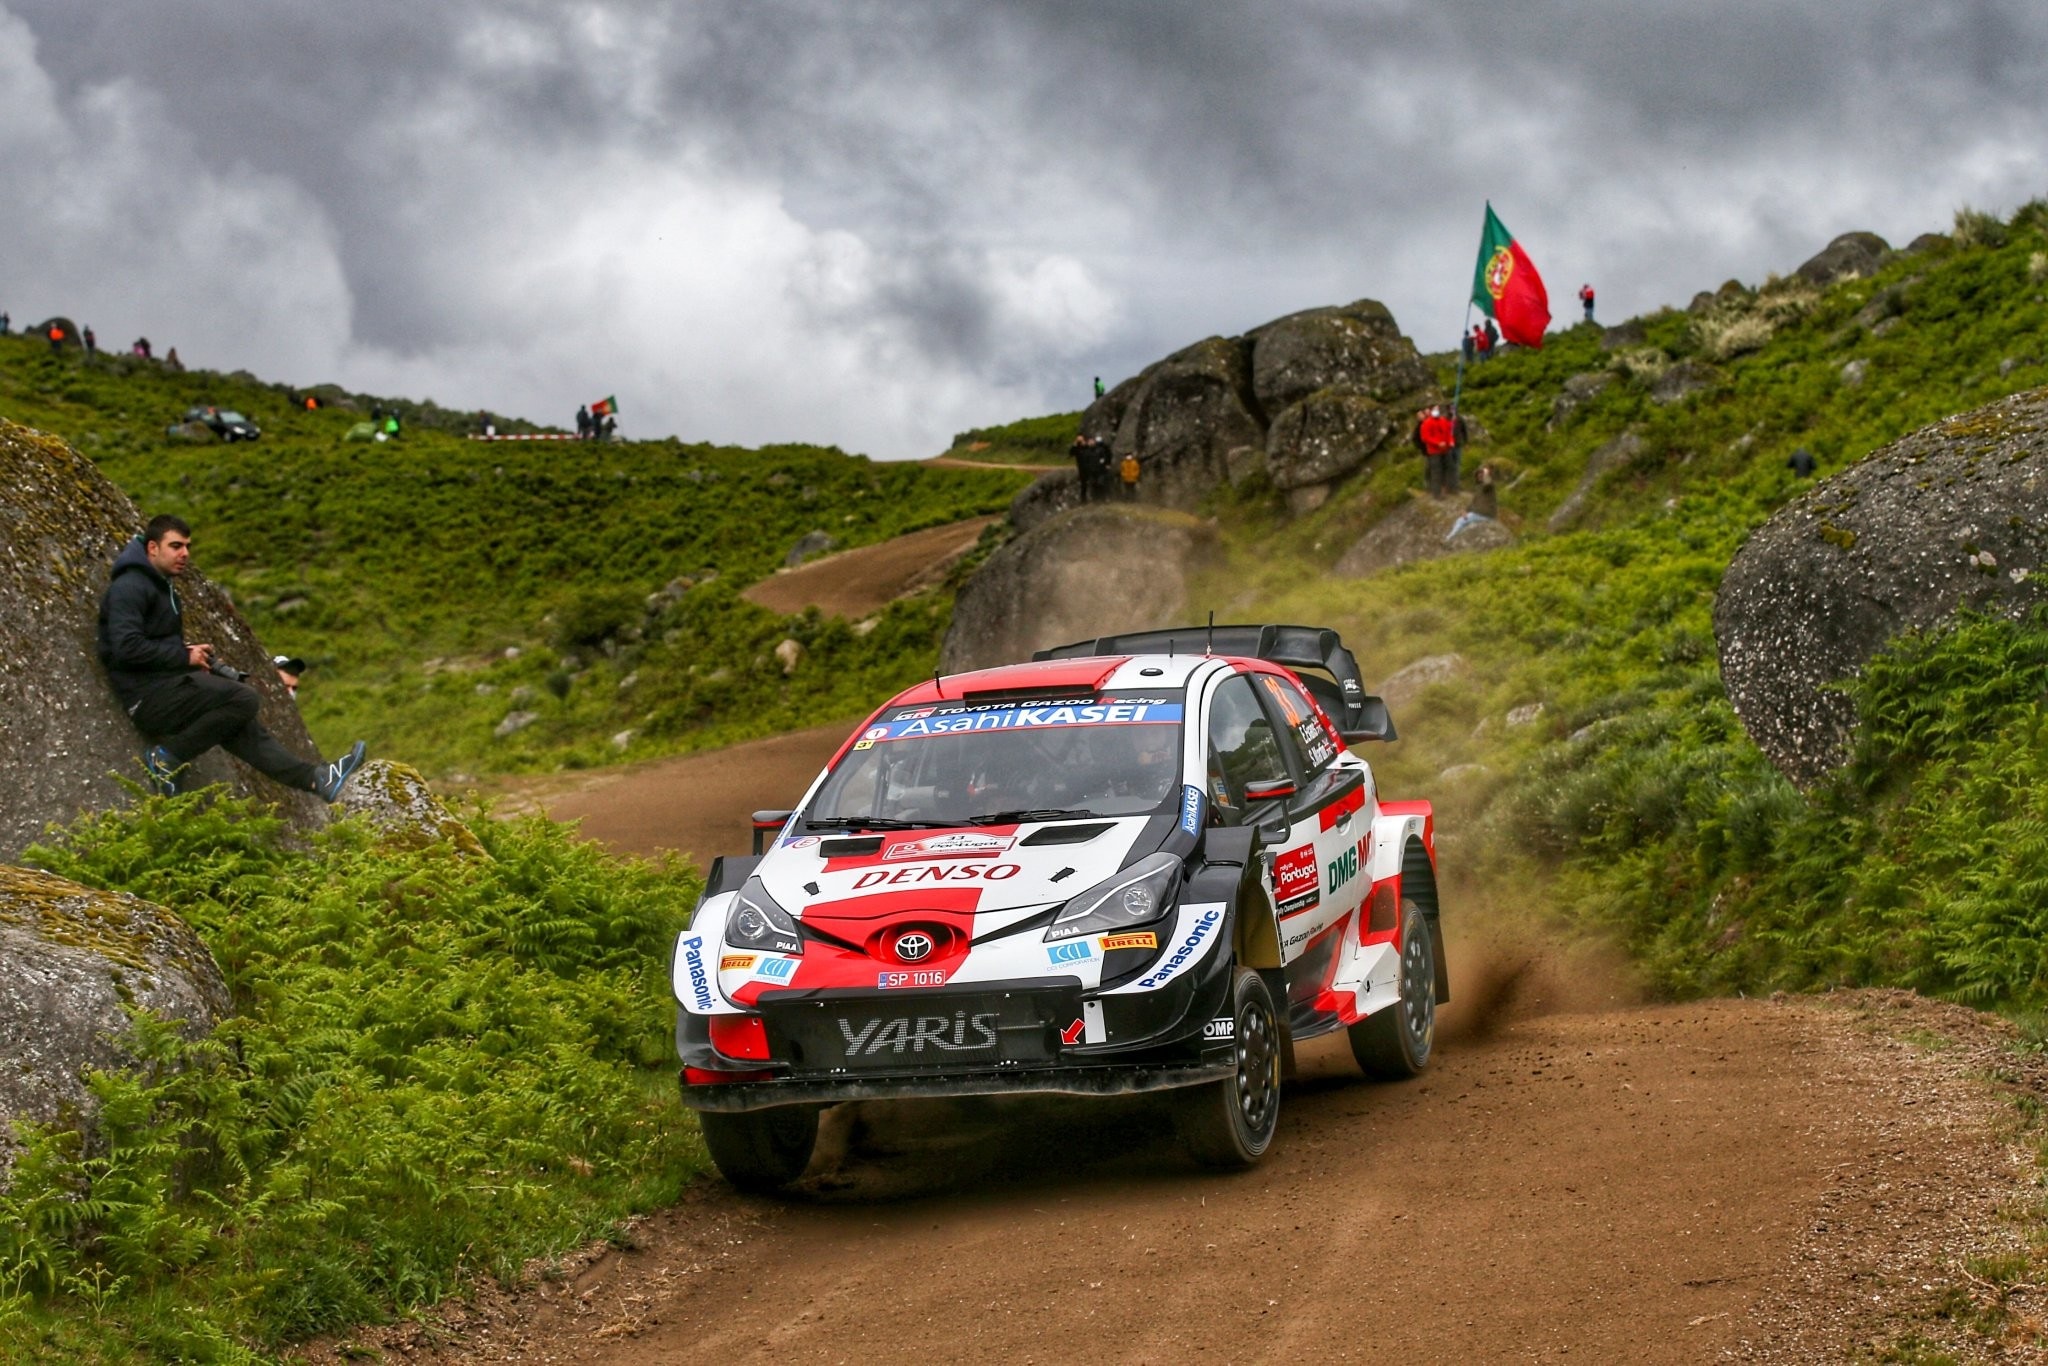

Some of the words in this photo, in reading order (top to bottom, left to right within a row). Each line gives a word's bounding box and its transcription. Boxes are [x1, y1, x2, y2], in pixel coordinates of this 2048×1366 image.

[938, 702, 1016, 716] TOYOTA
[1021, 699, 1094, 708] GAZOO
[1097, 697, 1167, 705] Racing
[852, 864, 1021, 890] DENSO
[1281, 860, 1317, 885] Portugal
[1328, 845, 1357, 895] DMG
[1051, 926, 1081, 938] PIAA
[776, 941, 797, 951] PIAA
[1102, 934, 1153, 948] PIRELLI
[1137, 910, 1220, 988] Panasonic
[720, 956, 754, 970] PIRELLI
[683, 936, 717, 1010] Panasonic
[888, 973, 909, 986] SP
[913, 971, 943, 985] 1016
[1203, 1021, 1234, 1036] OMP
